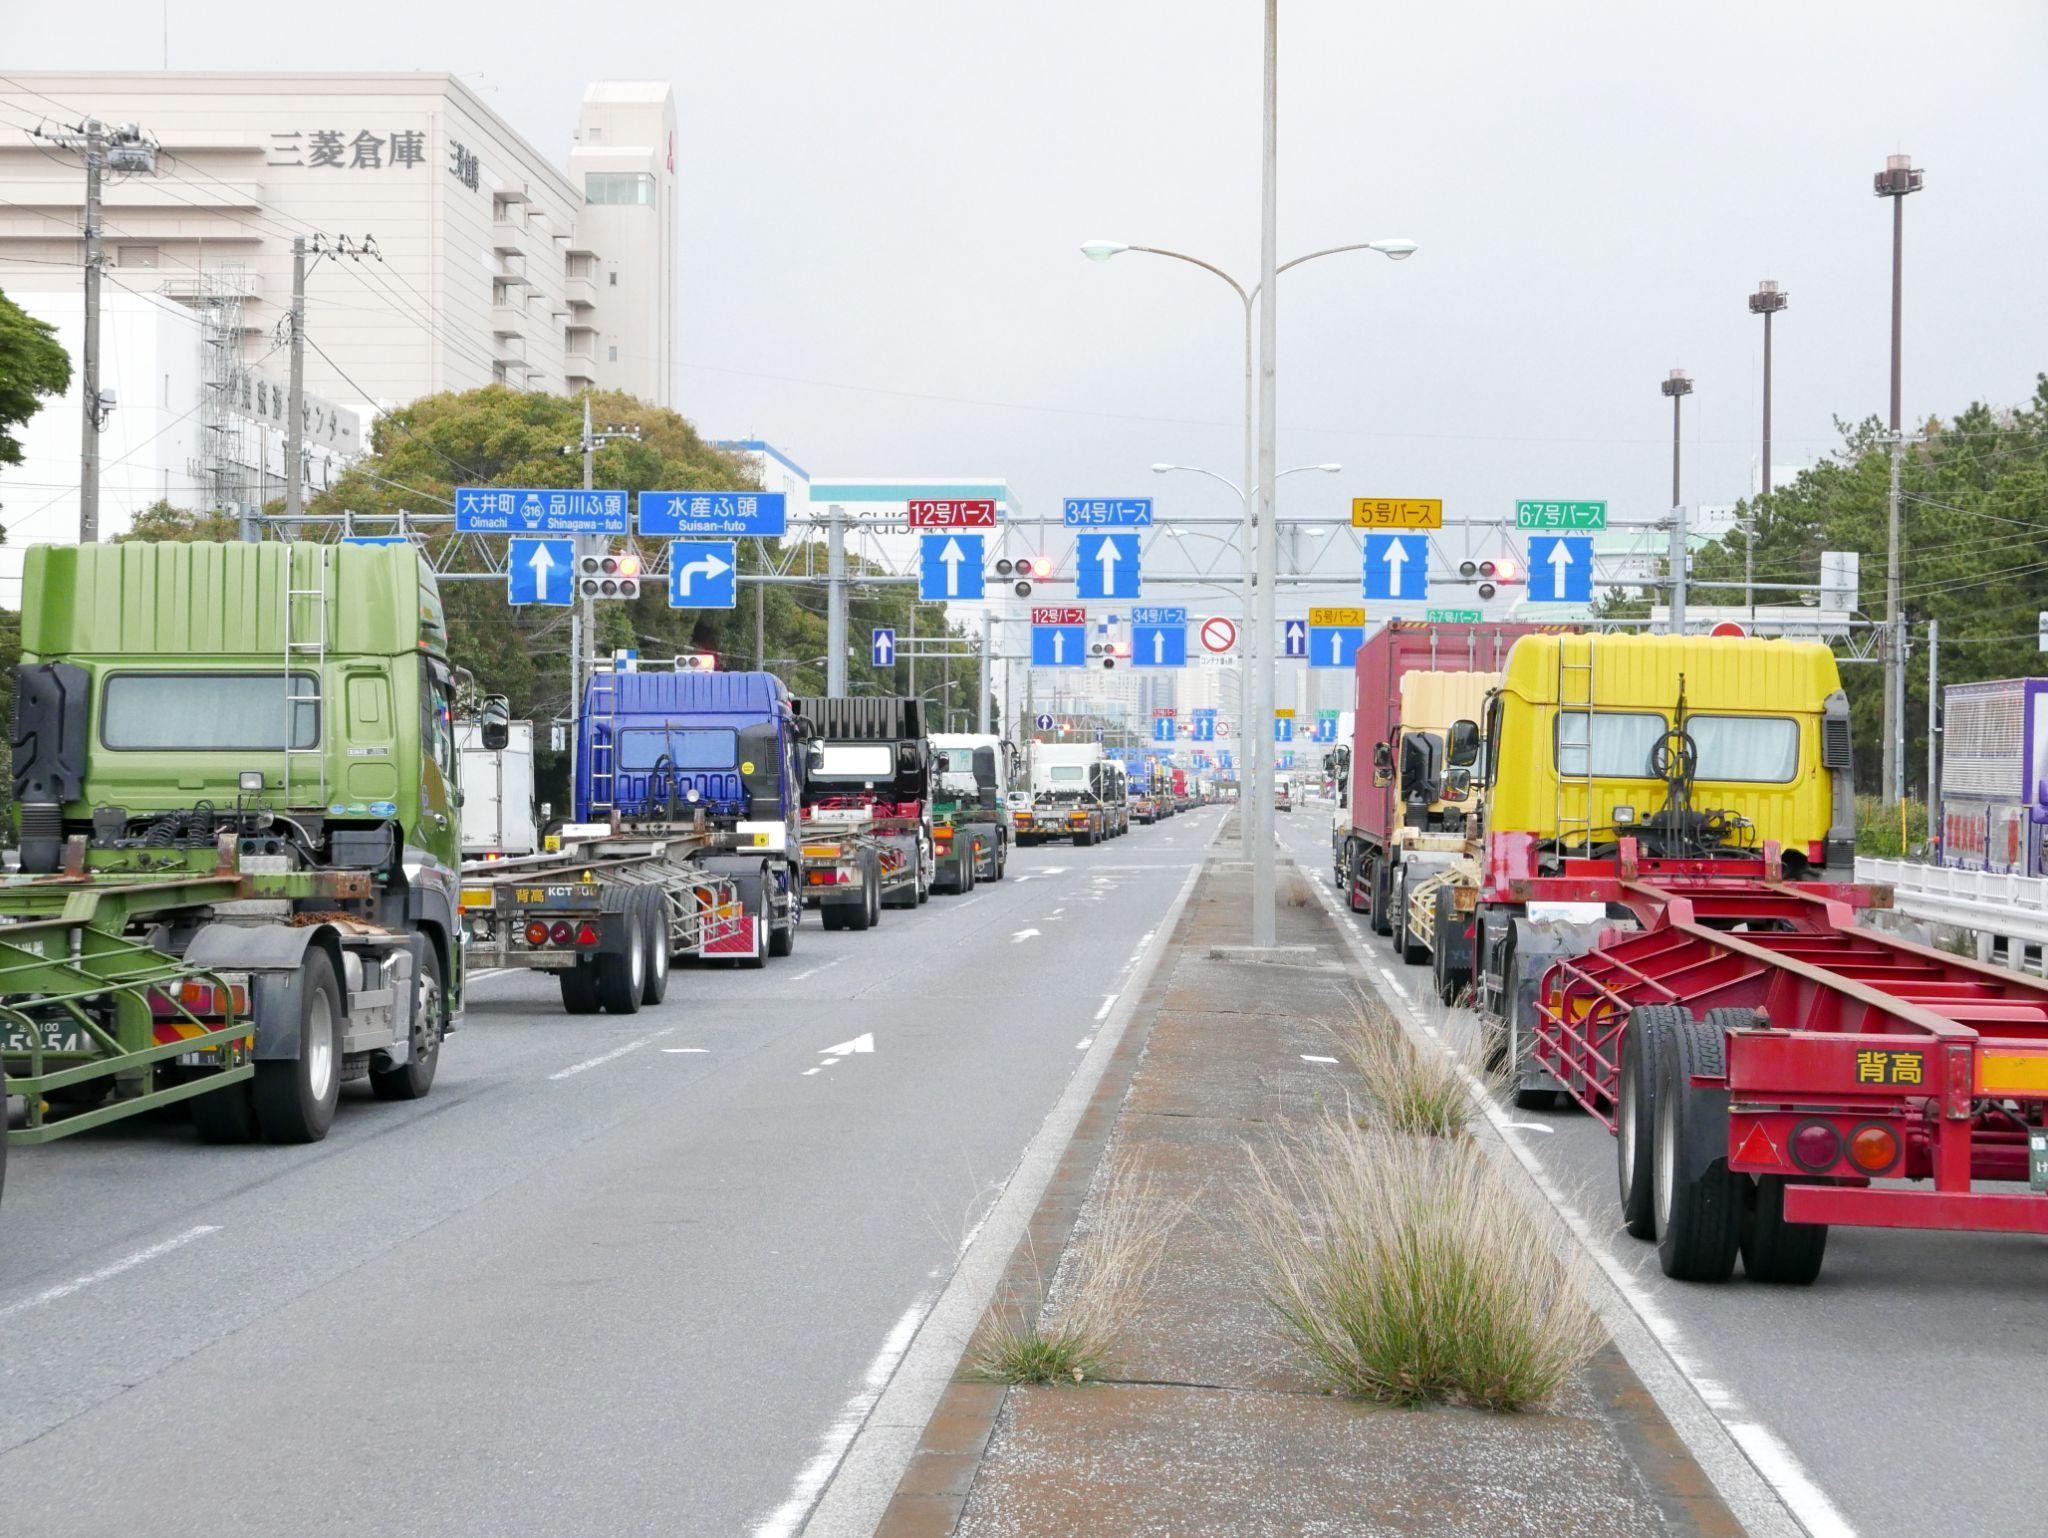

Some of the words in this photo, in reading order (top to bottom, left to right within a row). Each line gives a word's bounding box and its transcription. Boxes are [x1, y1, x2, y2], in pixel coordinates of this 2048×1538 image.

[267, 129, 427, 170] 三菱倉庫
[462, 494, 514, 515] 大井町
[524, 505, 541, 517] 316
[549, 494, 622, 517] 品川ふ頭
[667, 497, 758, 518] 水産ふ頭
[1361, 502, 1433, 524] 5号バース
[470, 516, 508, 528] Oimachi
[678, 519, 746, 532] Suisan-futo
[1314, 611, 1360, 624] 5号バース
[515, 887, 545, 904] 背高
[548, 886, 573, 896] KCT
[1856, 1051, 1924, 1084] 背高
